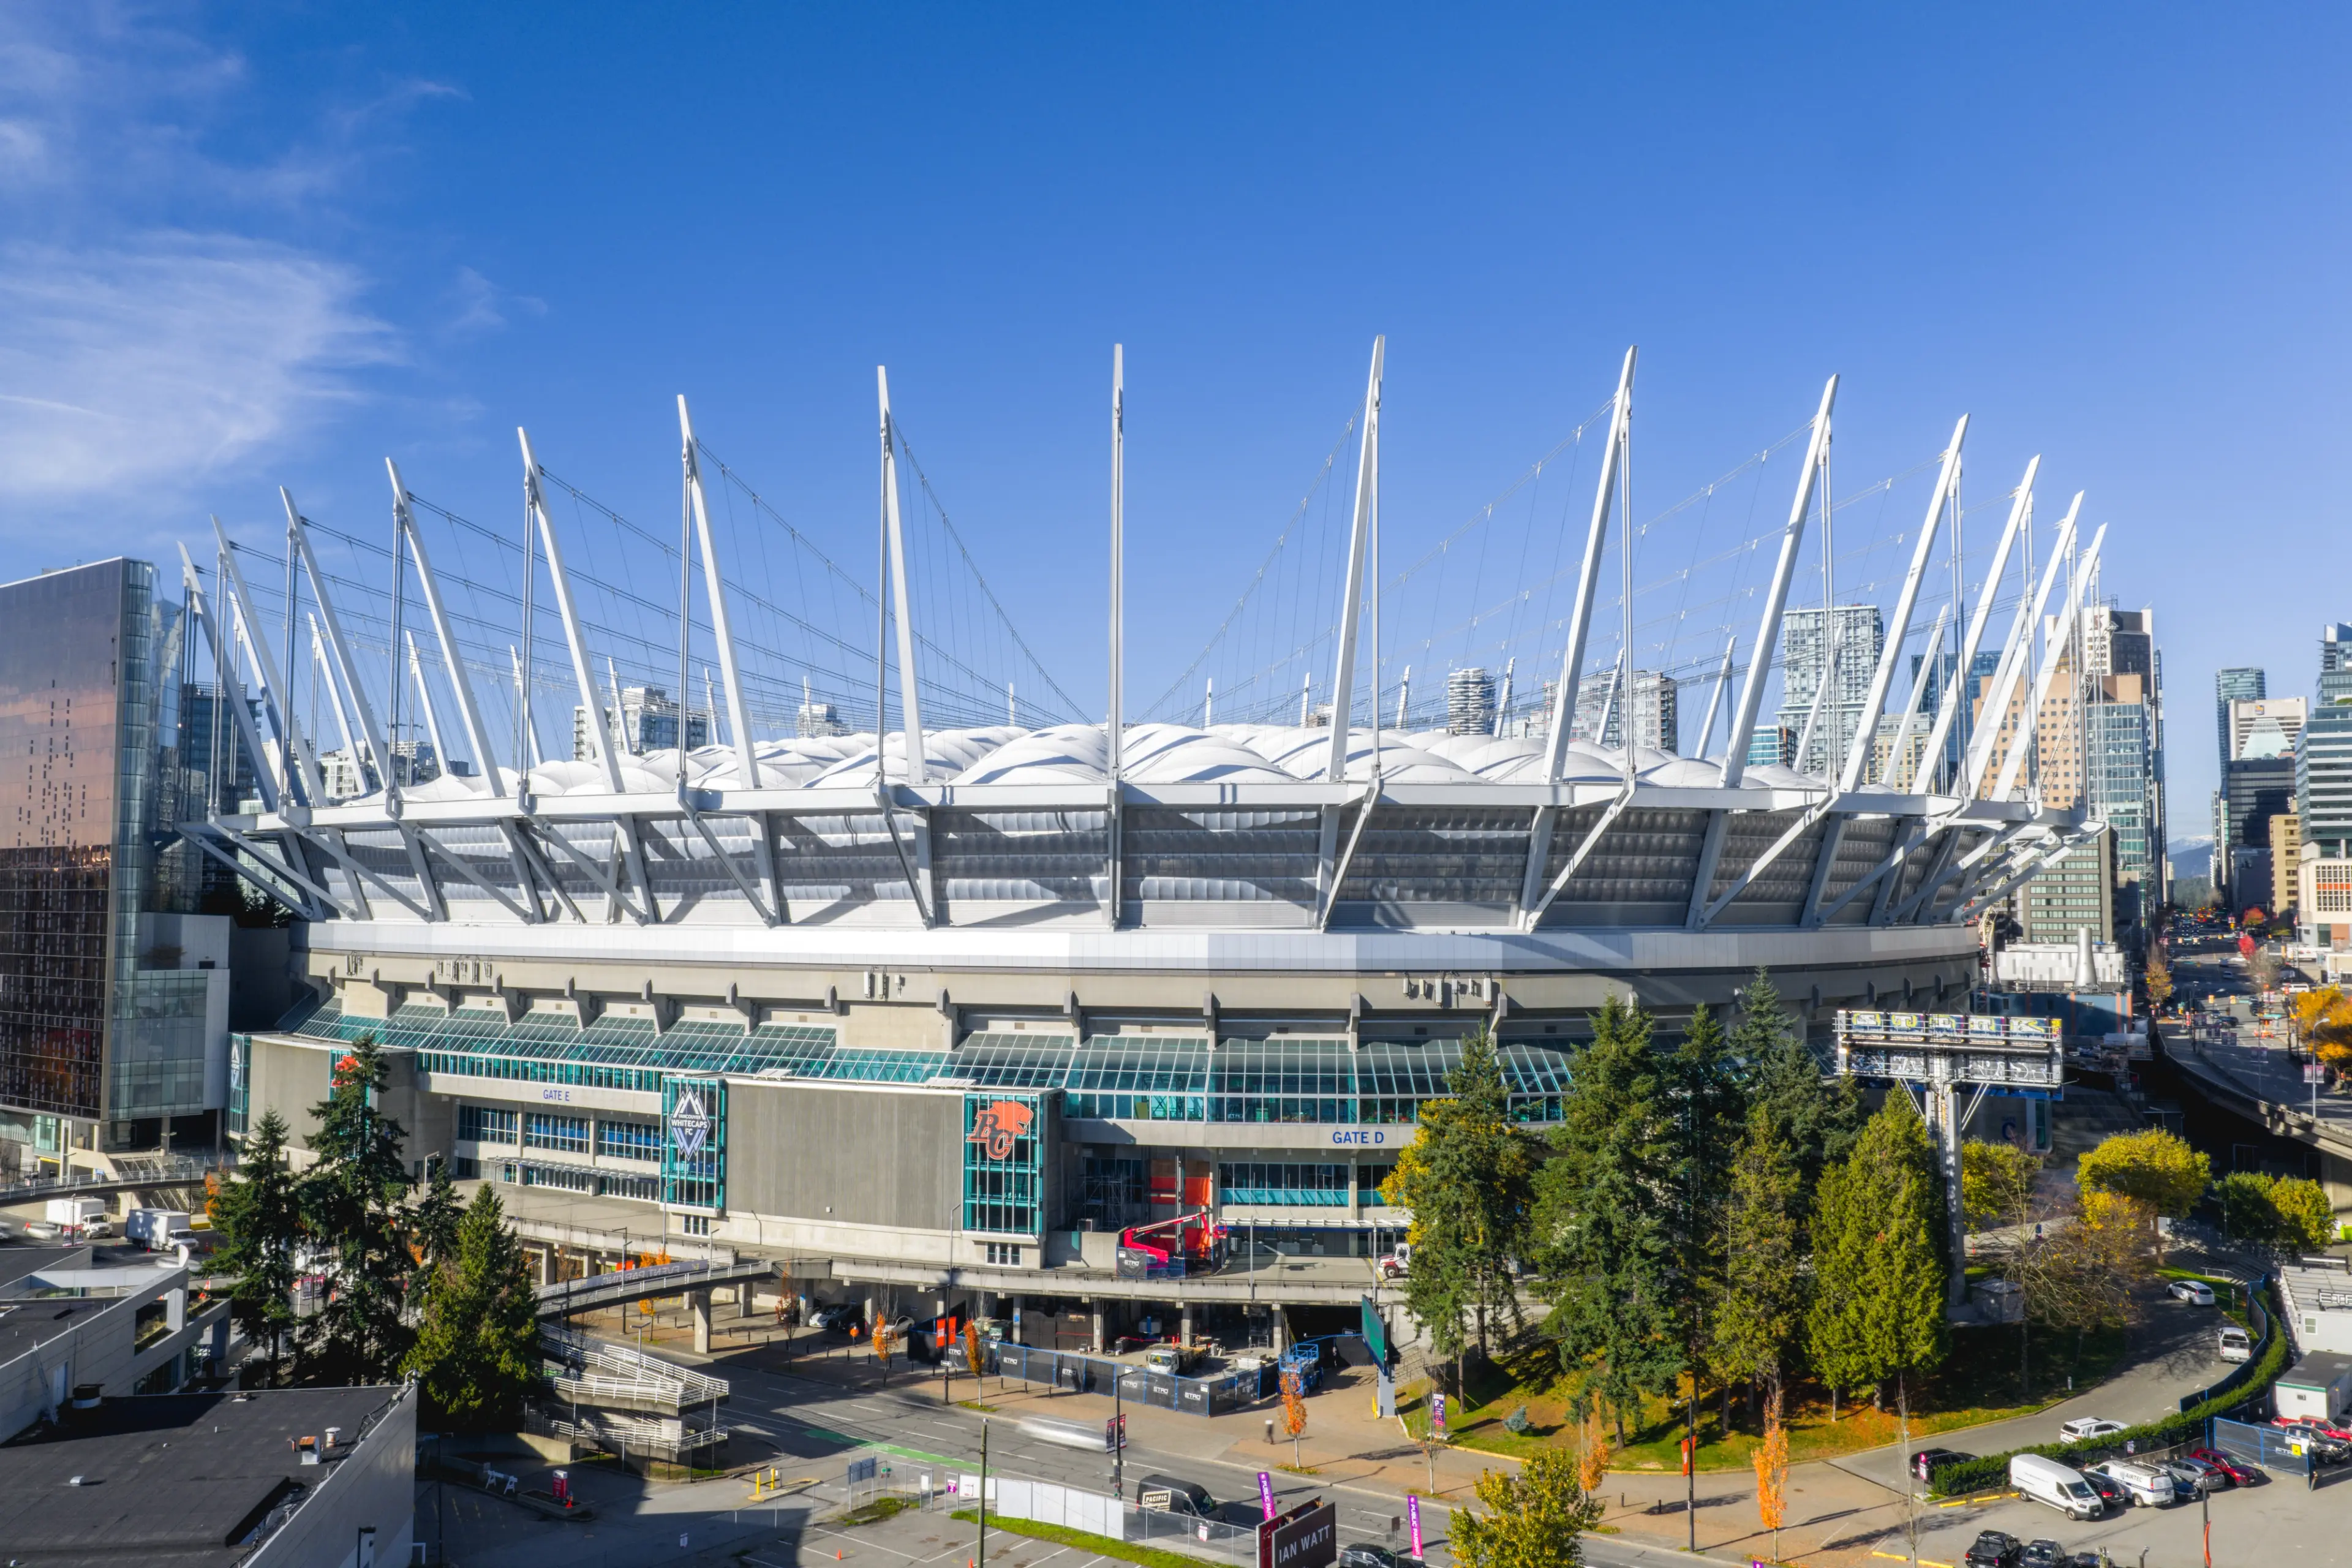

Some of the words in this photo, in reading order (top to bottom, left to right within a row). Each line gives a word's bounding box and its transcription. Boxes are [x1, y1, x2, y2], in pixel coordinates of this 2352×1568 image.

[543, 1089, 562, 1100] GATE
[565, 1091, 570, 1101] E
[671, 1120, 707, 1128] WHITECAPS
[966, 1110, 1014, 1159] BC
[1333, 1131, 1369, 1144] GATE
[1374, 1131, 1384, 1144] D
[1185, 1392, 1200, 1401] ETRO
[2275, 1447, 2294, 1456] ETR
[2125, 1473, 2143, 1482] AIRTEC
[1279, 1542, 1297, 1564] IAN
[1301, 1525, 1330, 1551] WATT
